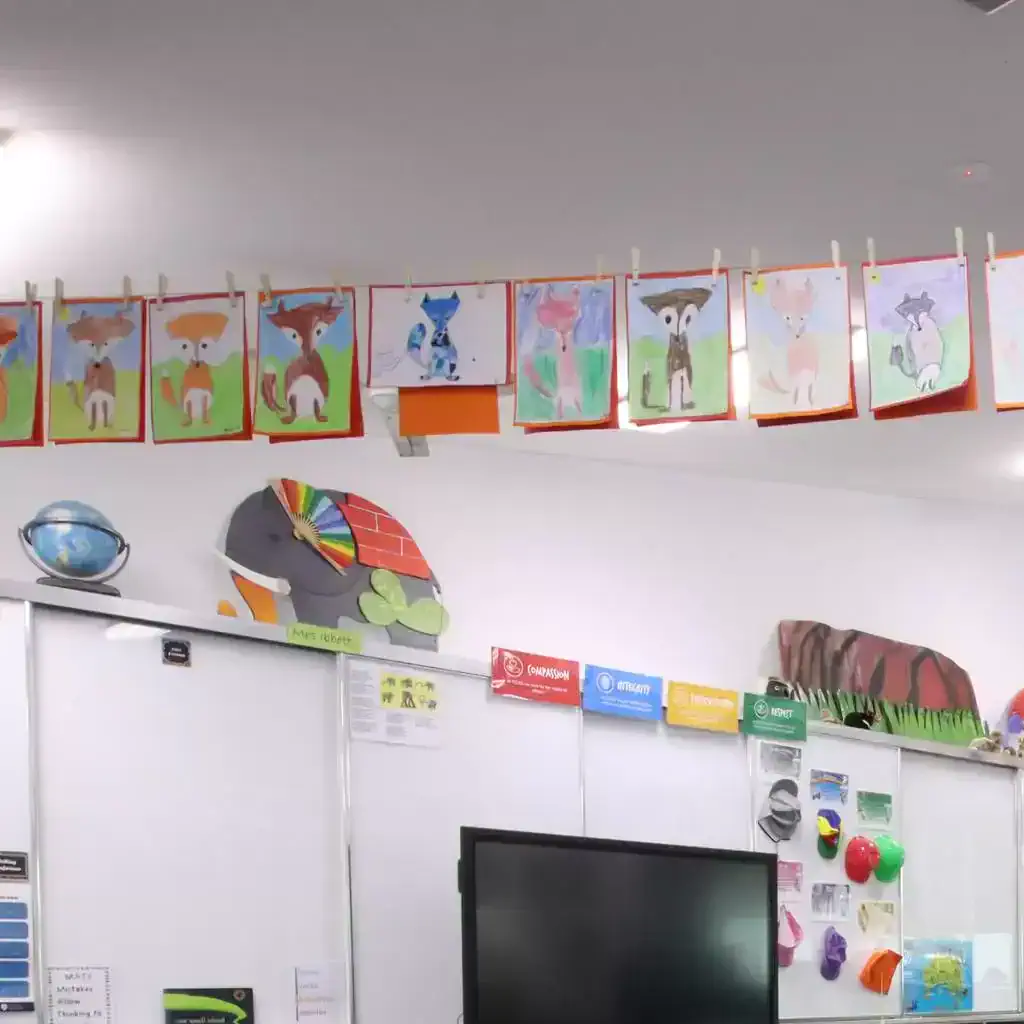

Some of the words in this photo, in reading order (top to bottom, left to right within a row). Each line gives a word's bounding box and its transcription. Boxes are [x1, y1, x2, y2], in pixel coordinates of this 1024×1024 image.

[527, 664, 570, 681] COMPASSION
[617, 680, 651, 696] INTEGRITY
[771, 707, 794, 720] RESPECT
